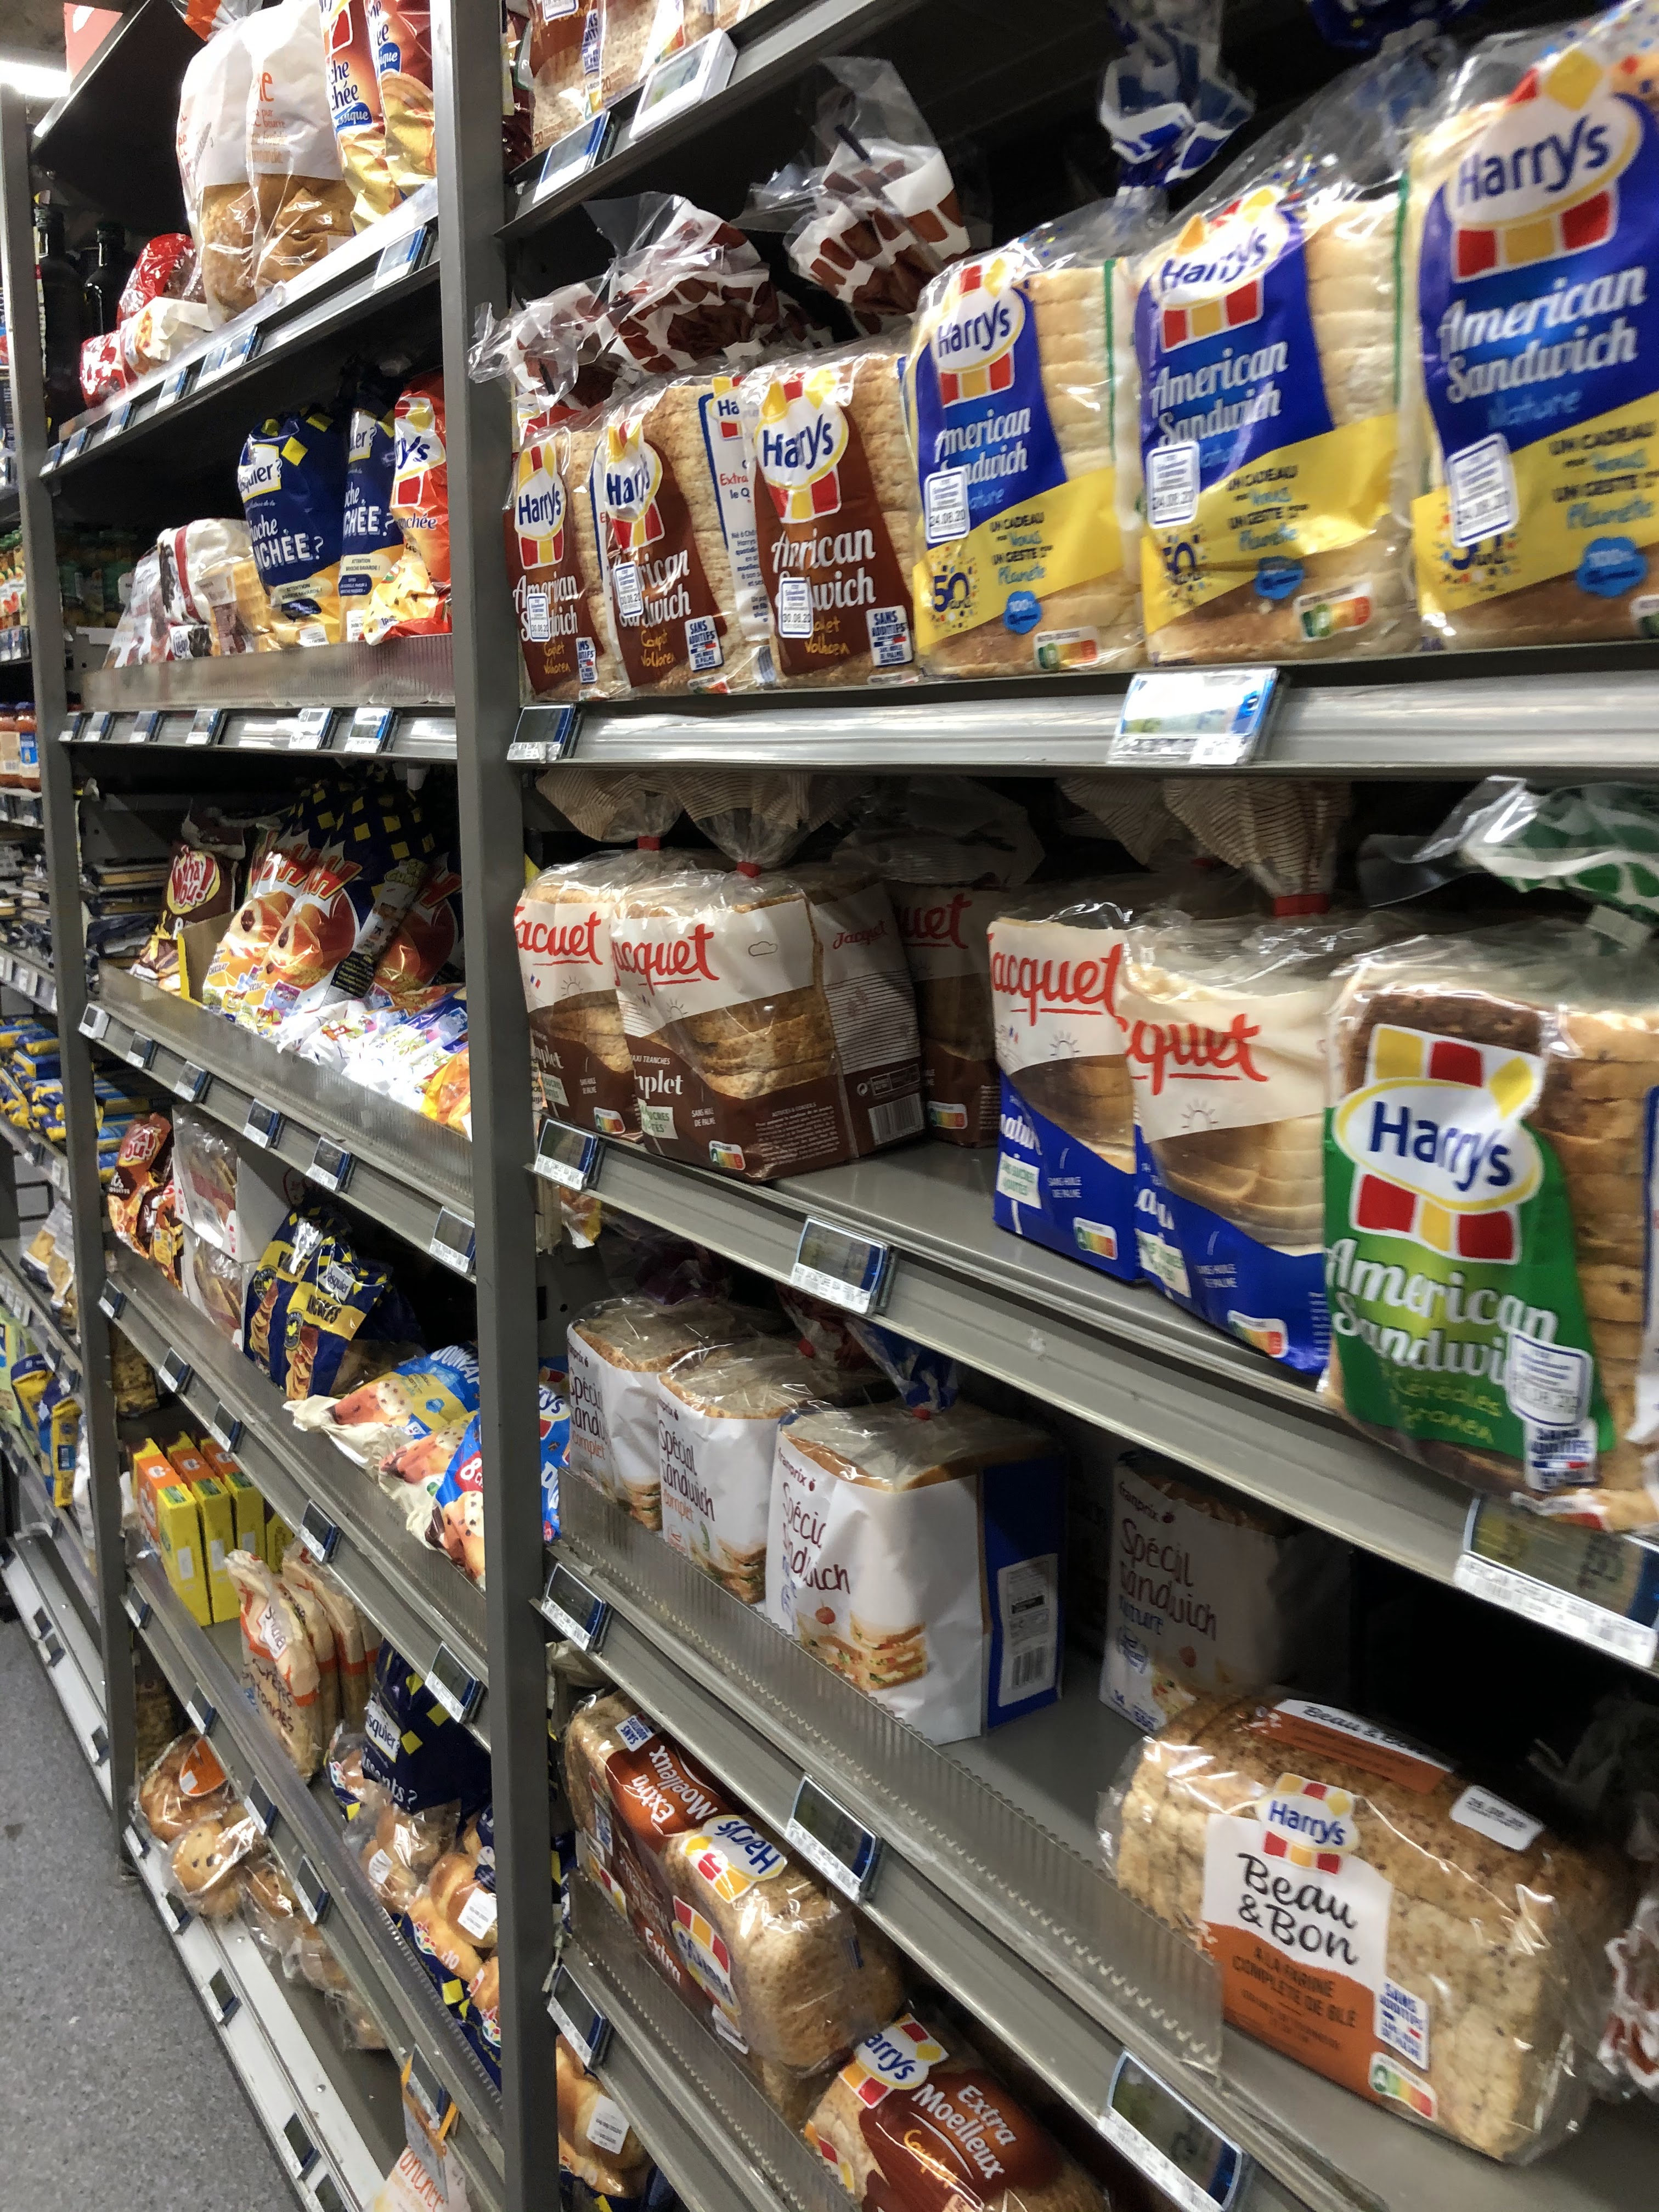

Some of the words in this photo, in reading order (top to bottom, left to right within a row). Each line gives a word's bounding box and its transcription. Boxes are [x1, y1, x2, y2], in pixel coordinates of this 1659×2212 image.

[534, 131, 544, 148] 20
[938, 300, 1011, 358] Harrys
[1437, 266, 1647, 363] American
[1150, 340, 1289, 419] American
[1446, 314, 1639, 405] Sandwich
[1158, 380, 1282, 447] Sandwich
[720, 473, 749, 486] Extra
[730, 489, 739, 499] le
[940, 441, 1029, 486] ndwich
[518, 482, 562, 526] Harrys
[873, 610, 900, 625] SANS
[610, 923, 720, 996] acquet
[990, 941, 1126, 1028] acquet
[643, 1055, 671, 1066] TRANCHES
[691, 1109, 704, 1118] SANS
[694, 1119, 702, 1127] DE
[1366, 1099, 1515, 1192] Harrys
[1321, 1237, 1559, 1344] American
[1332, 1290, 1508, 1386] Sandwi
[658, 1419, 698, 1476] Spécial
[661, 1458, 716, 1522] sandwich
[1120, 1517, 1194, 1587] Spécil
[620, 1725, 639, 1746] SANS
[630, 1773, 675, 1825] Extra
[647, 1745, 719, 1821] Moelleux
[1235, 1852, 1359, 1931] Beau
[1237, 1893, 1264, 1929] &
[1263, 1902, 1359, 1966] Bon
[864, 2032, 917, 2081] arrys
[911, 2083, 1006, 2180] Moelleux
[957, 2084, 1017, 2146] Extra
